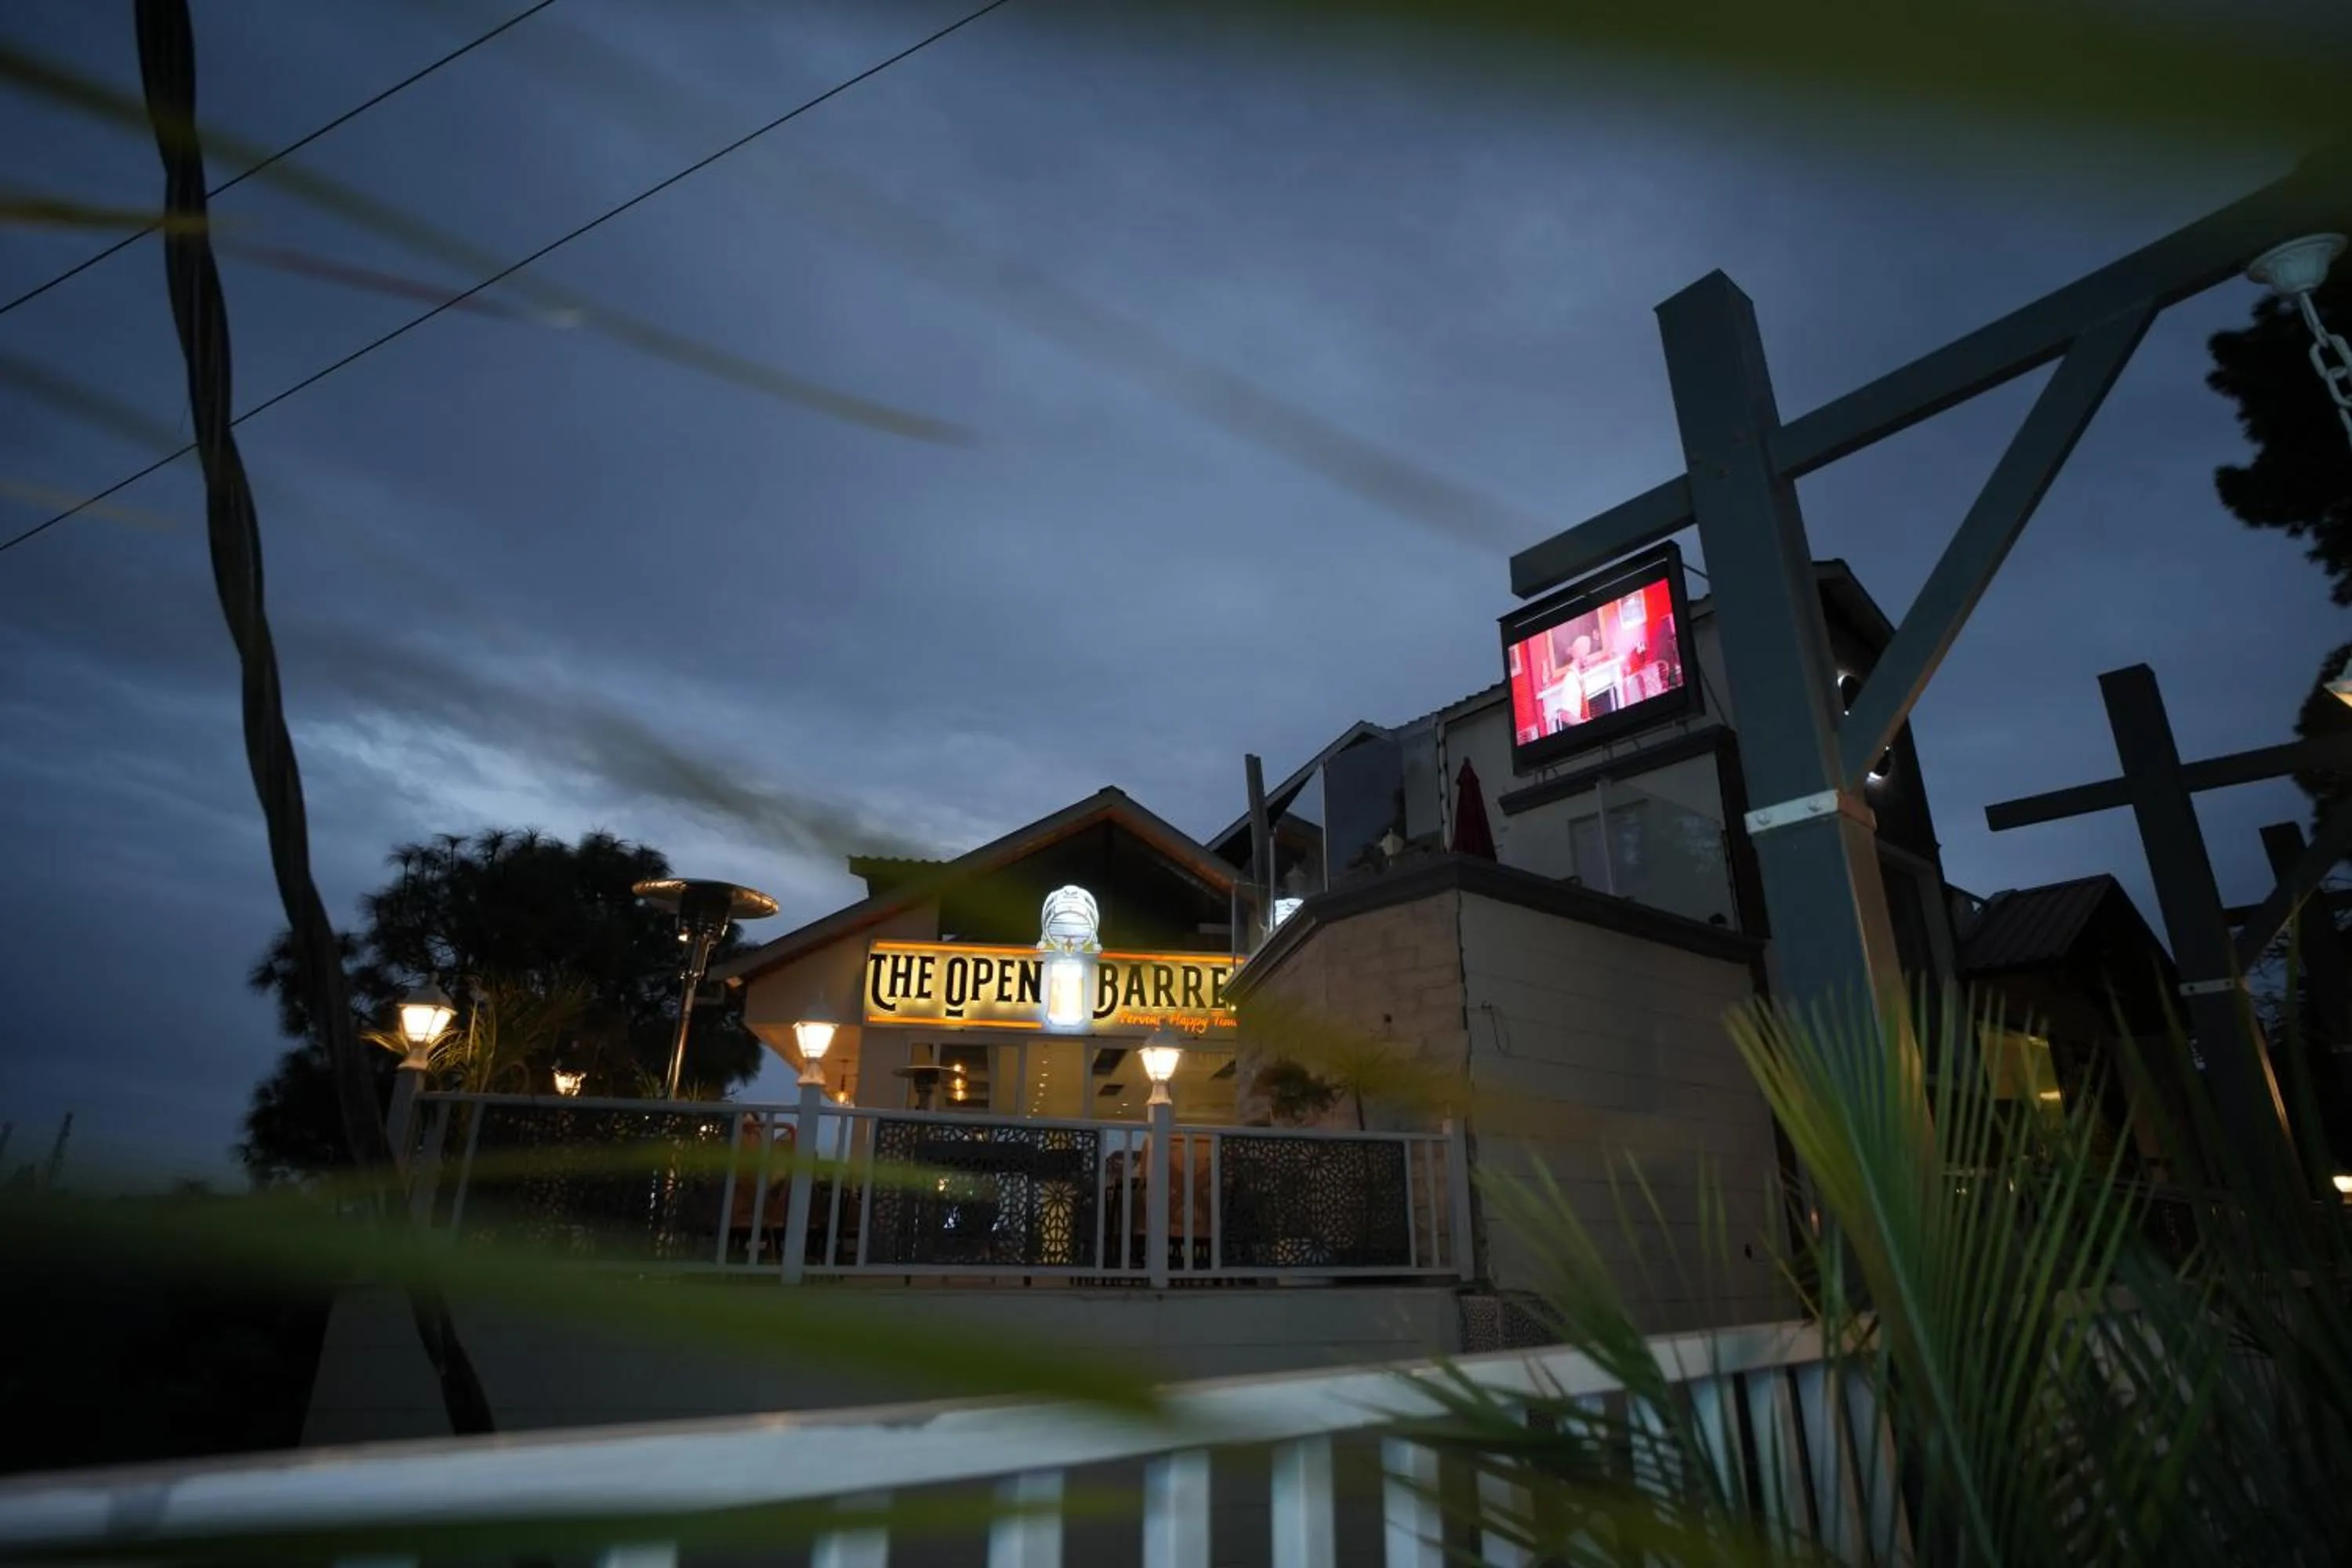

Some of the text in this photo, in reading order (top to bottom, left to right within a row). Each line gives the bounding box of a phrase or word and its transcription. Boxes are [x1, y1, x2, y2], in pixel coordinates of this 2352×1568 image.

[869, 953, 1228, 1019] THE OPEN BARRE
[1169, 1011, 1209, 1034] Happy
